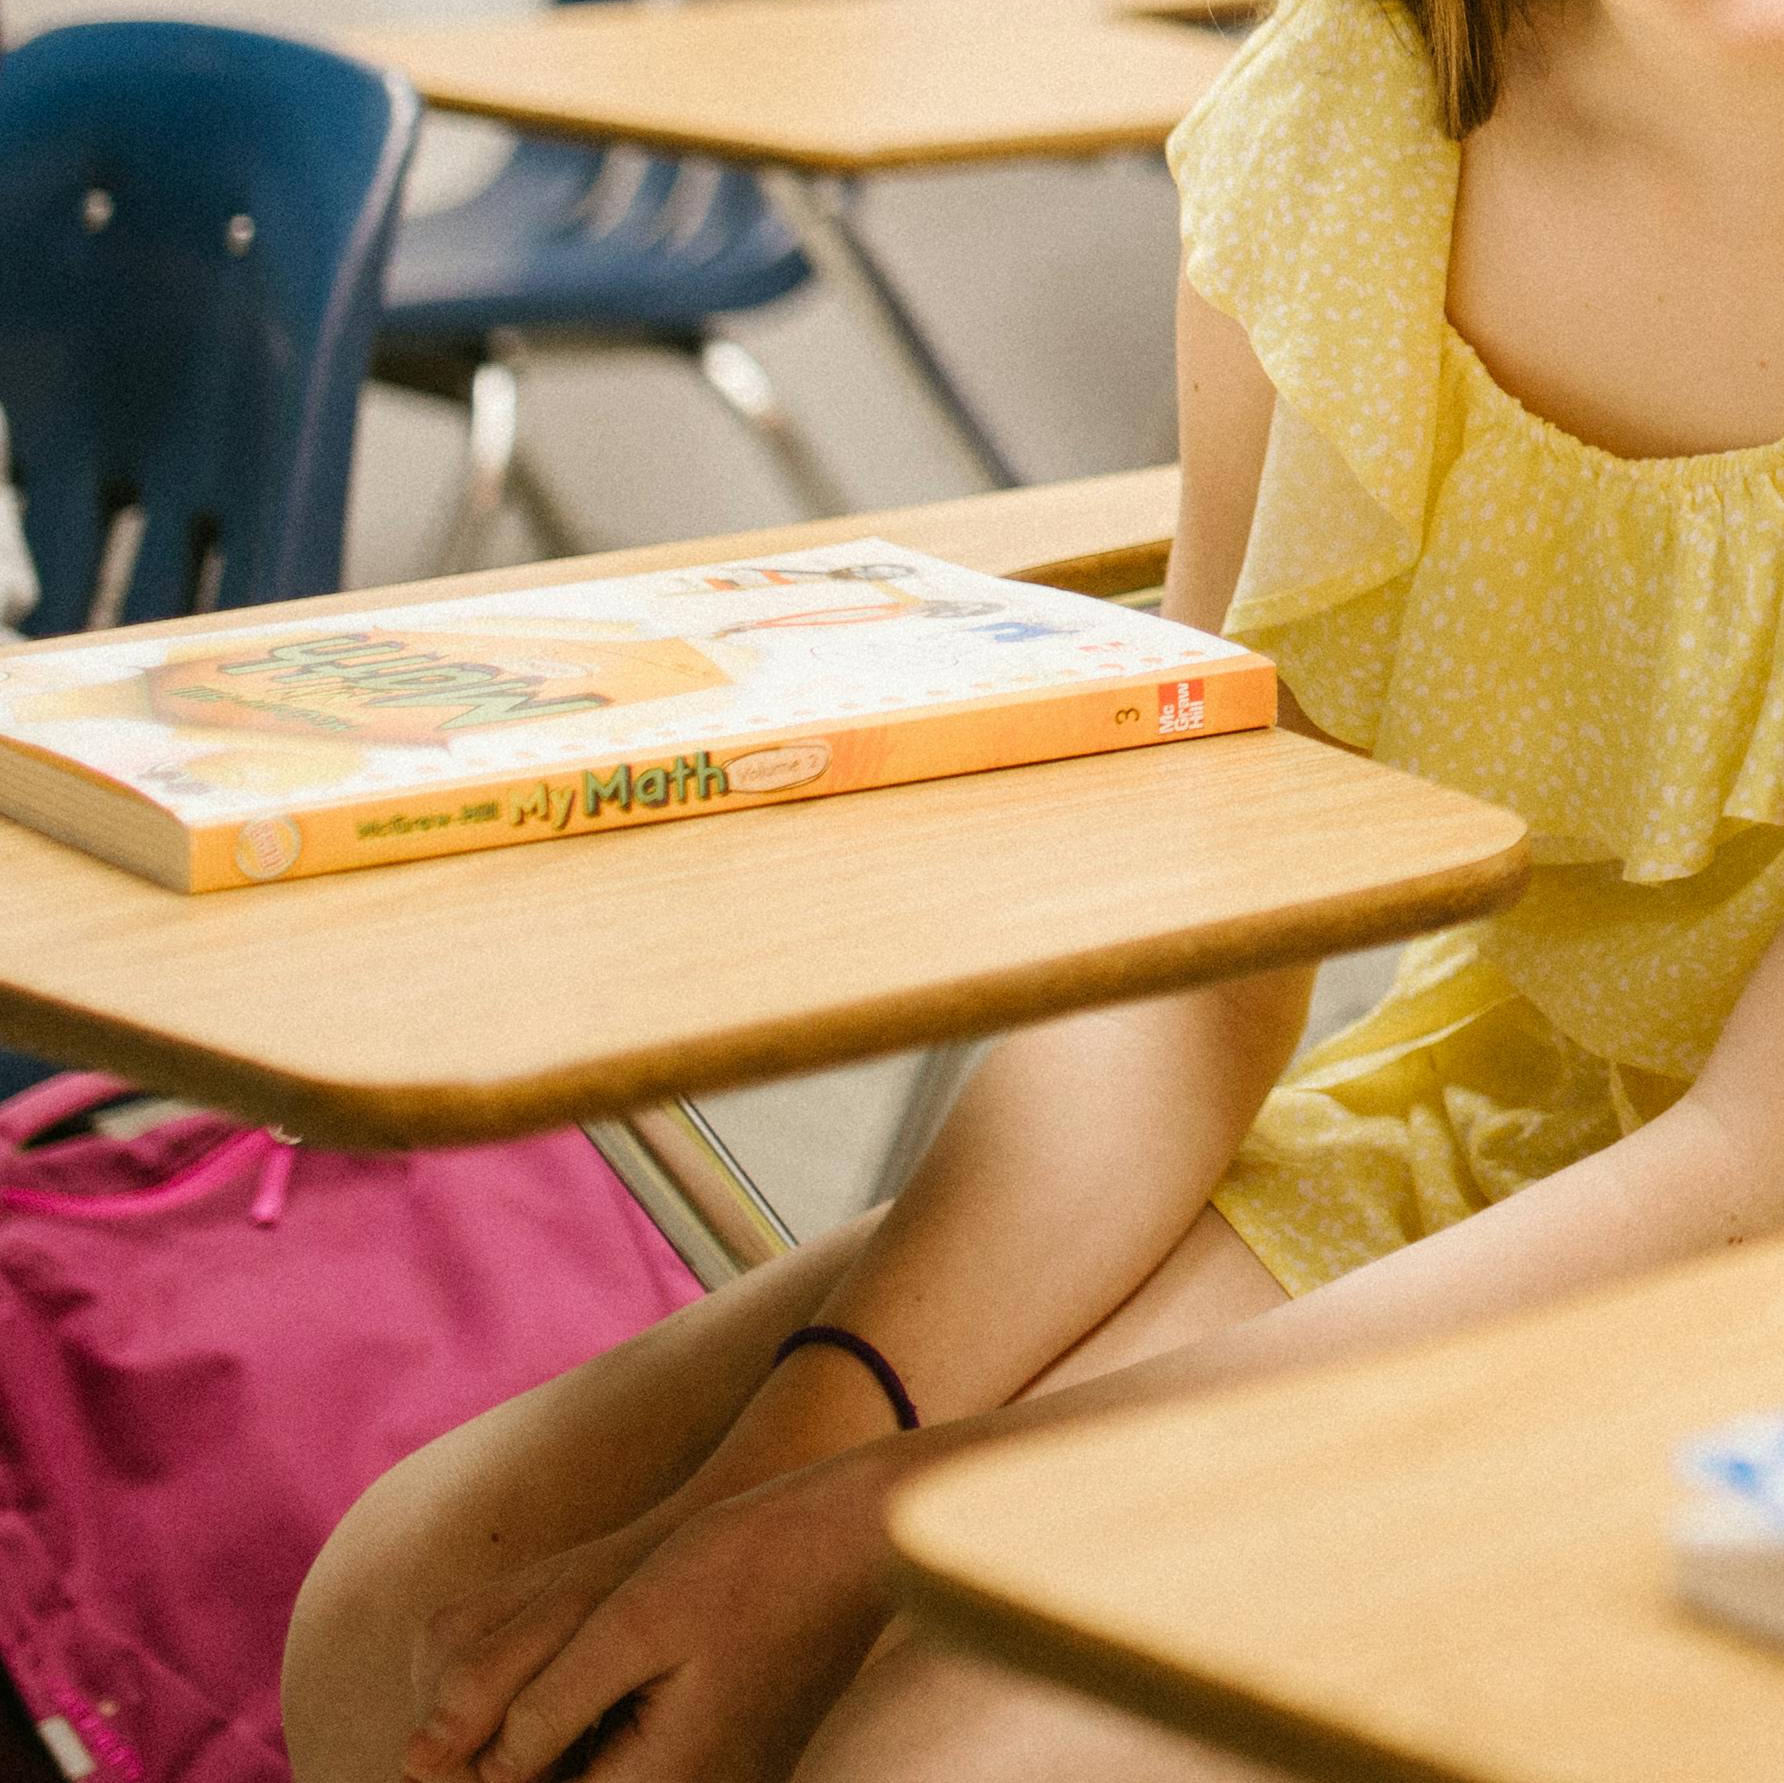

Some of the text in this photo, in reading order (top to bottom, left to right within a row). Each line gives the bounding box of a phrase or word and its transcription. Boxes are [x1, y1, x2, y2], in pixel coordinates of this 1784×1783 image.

[1115, 707, 1141, 725] 3
[1159, 703, 1176, 735] Mc
[1173, 681, 1190, 732] Graw
[1188, 699, 1205, 730] Hill
[509, 780, 574, 831] My
[583, 749, 732, 818] Math
